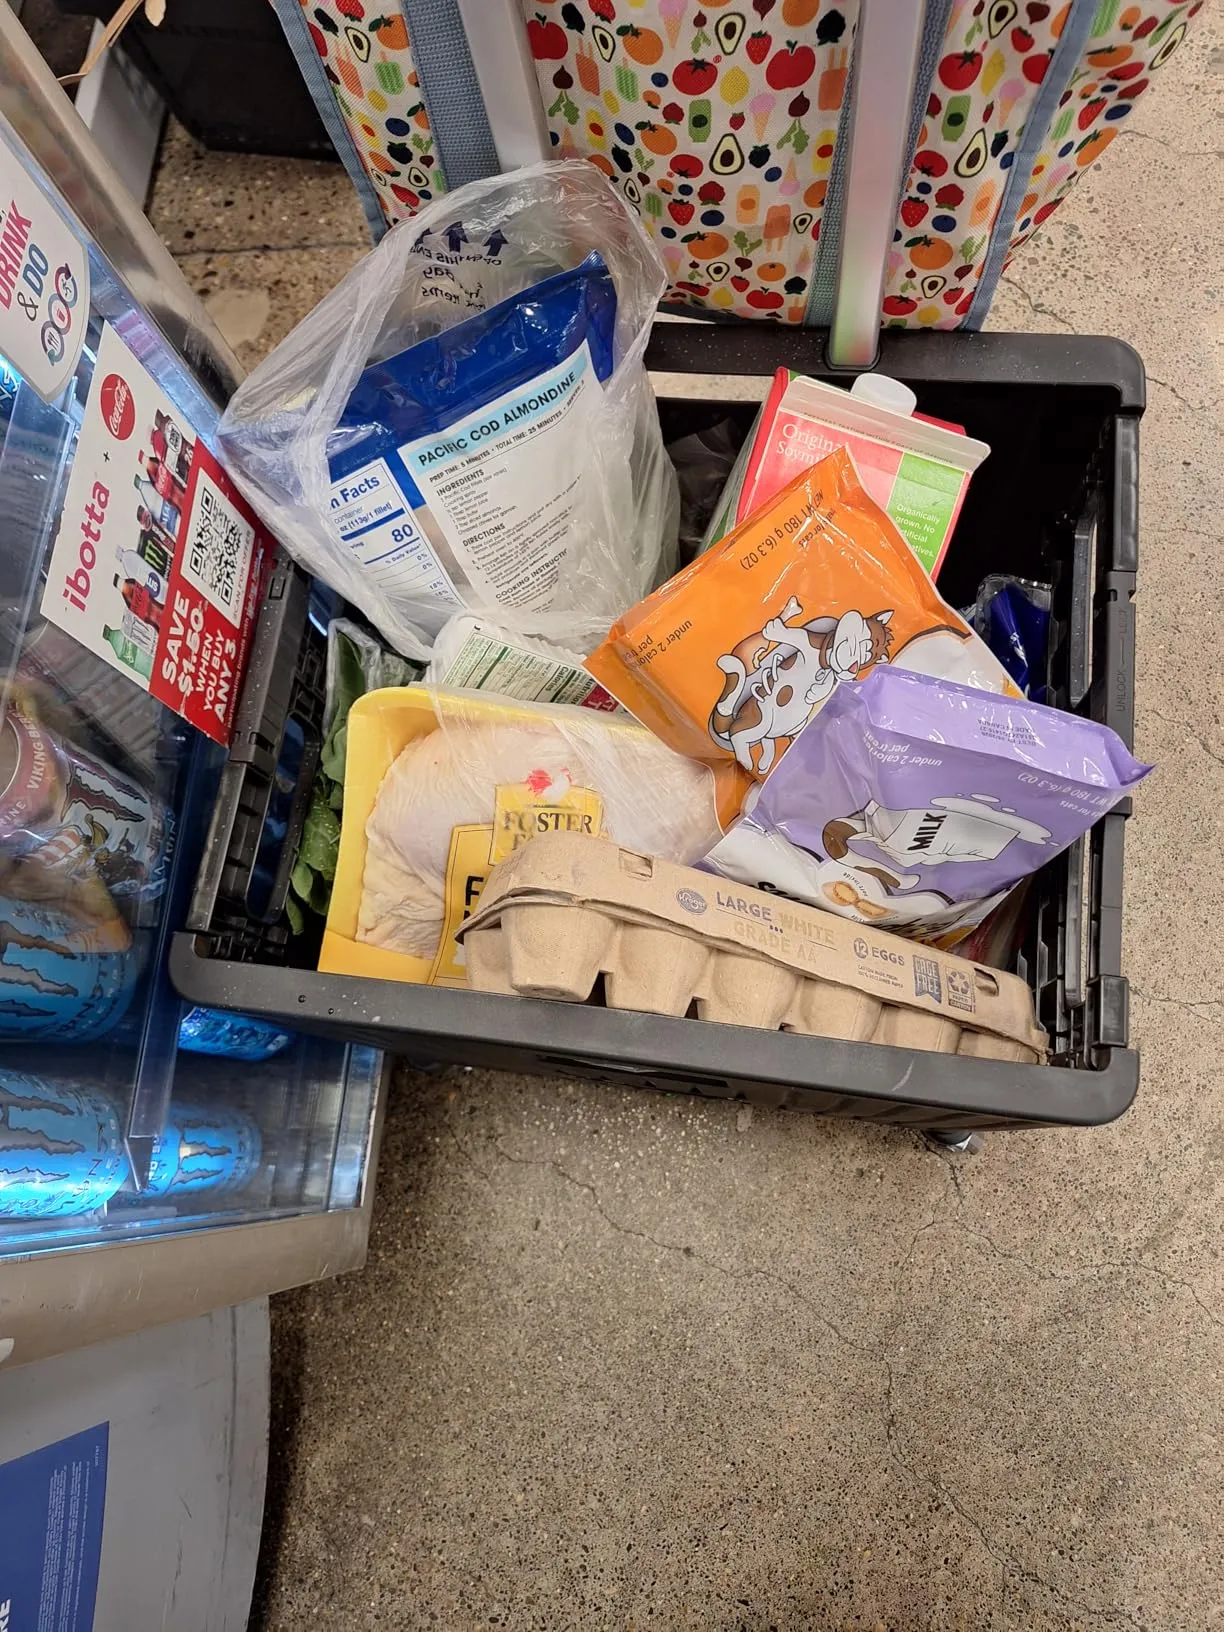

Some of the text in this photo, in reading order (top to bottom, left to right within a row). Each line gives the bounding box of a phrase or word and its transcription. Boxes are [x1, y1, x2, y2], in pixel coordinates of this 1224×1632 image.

[23, 243, 49, 297] DO
[418, 371, 576, 466] PACIFIC COD ALMONDINE
[428, 470, 444, 483] PREP
[465, 449, 490, 465] MINUTES
[495, 437, 512, 450] TOTAL
[511, 430, 527, 442] TIME:
[527, 425, 536, 434] 25
[536, 409, 562, 429] MINUTES
[339, 474, 380, 503] Facts
[436, 468, 485, 496] INGREDIENTS
[781, 514, 803, 534] 180
[896, 503, 940, 525] Organically
[390, 522, 414, 543] 80
[462, 522, 505, 547] DIRECTIONS
[772, 526, 784, 538] g
[923, 524, 936, 535] No
[62, 481, 110, 612] ibotta
[754, 533, 778, 557] (6.3
[737, 549, 760, 571] OZ)
[495, 575, 530, 600] COOKING
[159, 589, 190, 684] SAVE
[635, 634, 653, 653] per
[664, 619, 692, 646] under
[656, 641, 667, 652] 2
[195, 632, 213, 691] WHEN
[203, 628, 224, 709] YOU BUY
[215, 637, 238, 723] ANY 3
[888, 743, 909, 753] per
[908, 755, 942, 766] under
[27, 741, 46, 790] VIKING
[1070, 787, 1091, 801] 180
[503, 810, 593, 834] FOSTER
[907, 811, 949, 852] MILK
[712, 891, 774, 922] LARGE
[775, 911, 837, 946] WHITE
[730, 920, 793, 953] GRADE
[869, 945, 906, 966] EGGS
[911, 956, 942, 978] CAGE
[913, 973, 943, 995] FREE
